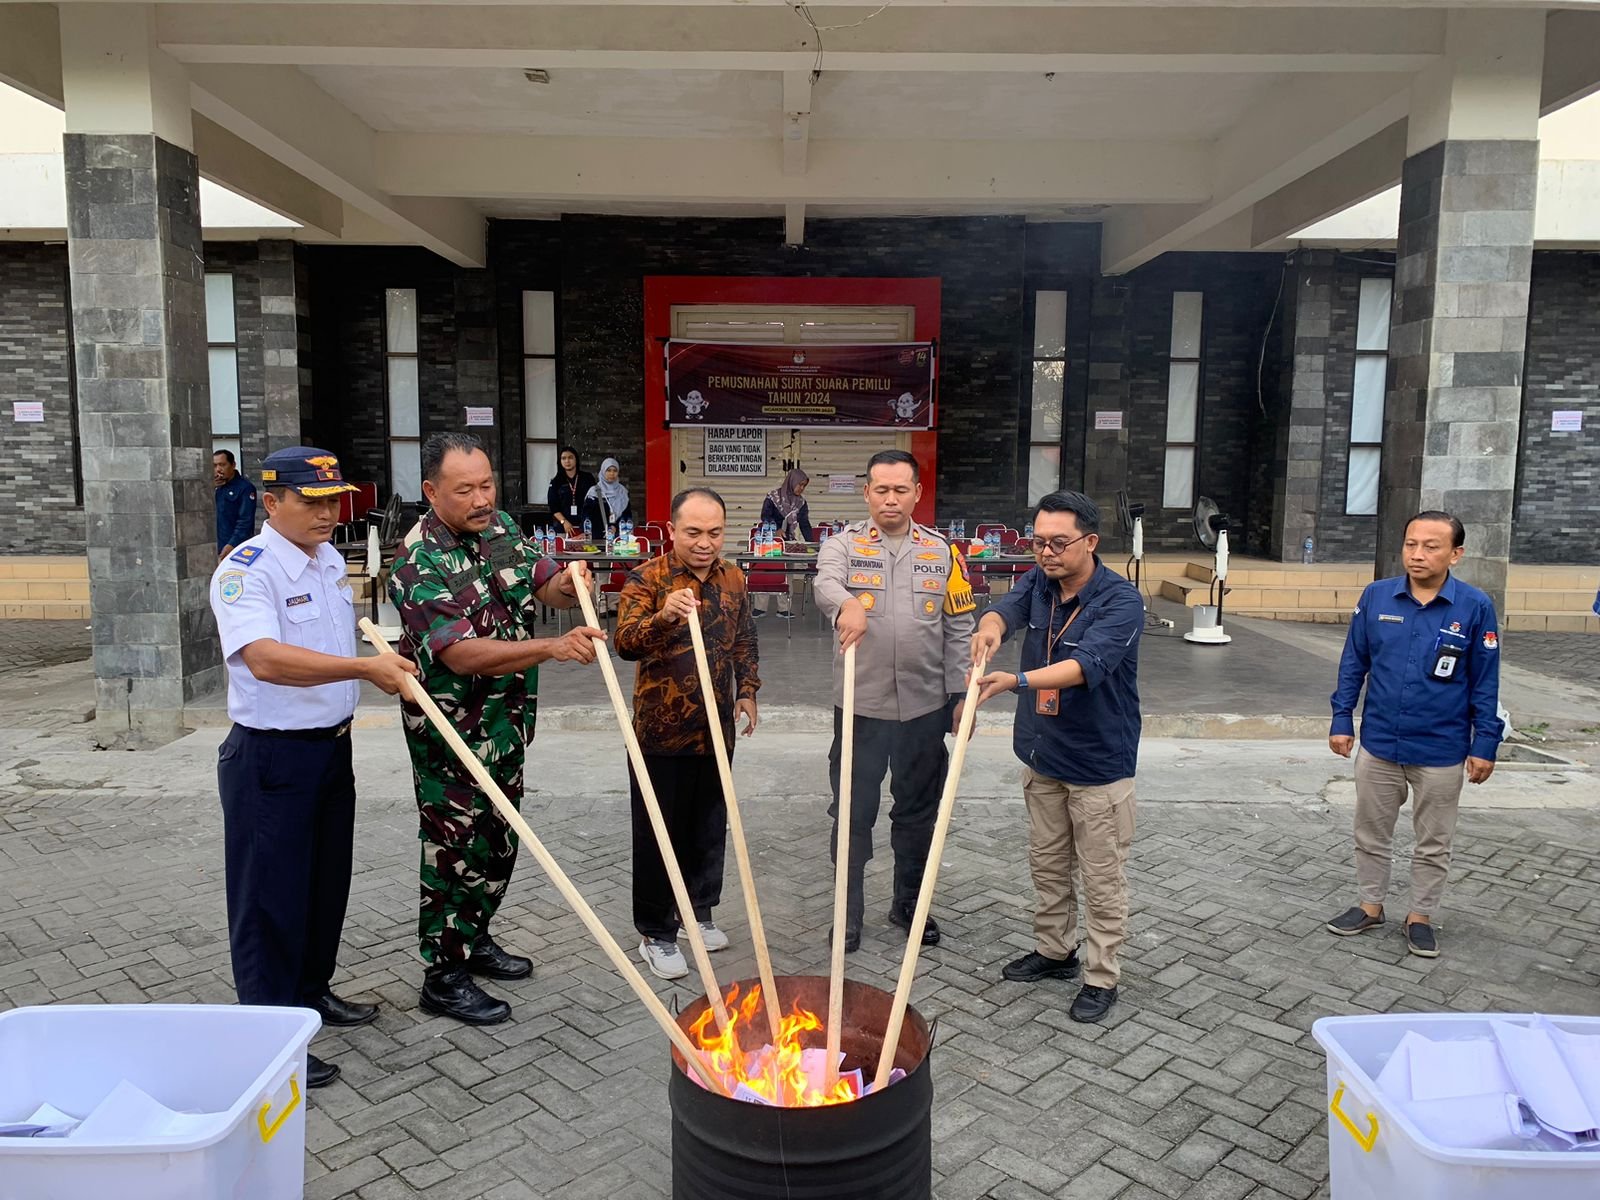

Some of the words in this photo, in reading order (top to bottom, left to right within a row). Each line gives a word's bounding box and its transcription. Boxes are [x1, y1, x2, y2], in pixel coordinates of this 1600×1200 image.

[708, 375, 778, 389] PEMUSNAHAN
[781, 377, 813, 390] SURAT
[815, 378, 849, 390] SUARA
[852, 378, 891, 391] PEMILU
[767, 391, 801, 404] TAHUN
[804, 392, 831, 404] 2024
[708, 428, 735, 439] HARAP
[737, 428, 763, 439] LAPOR
[709, 444, 724, 453] BAGI
[725, 445, 741, 453] YANG
[743, 445, 761, 453] TIDAK
[708, 454, 763, 463] BERKEPENTINGAN
[708, 464, 739, 472] DILARANG
[740, 464, 762, 472] MASUK
[913, 565, 946, 574] POLRI
